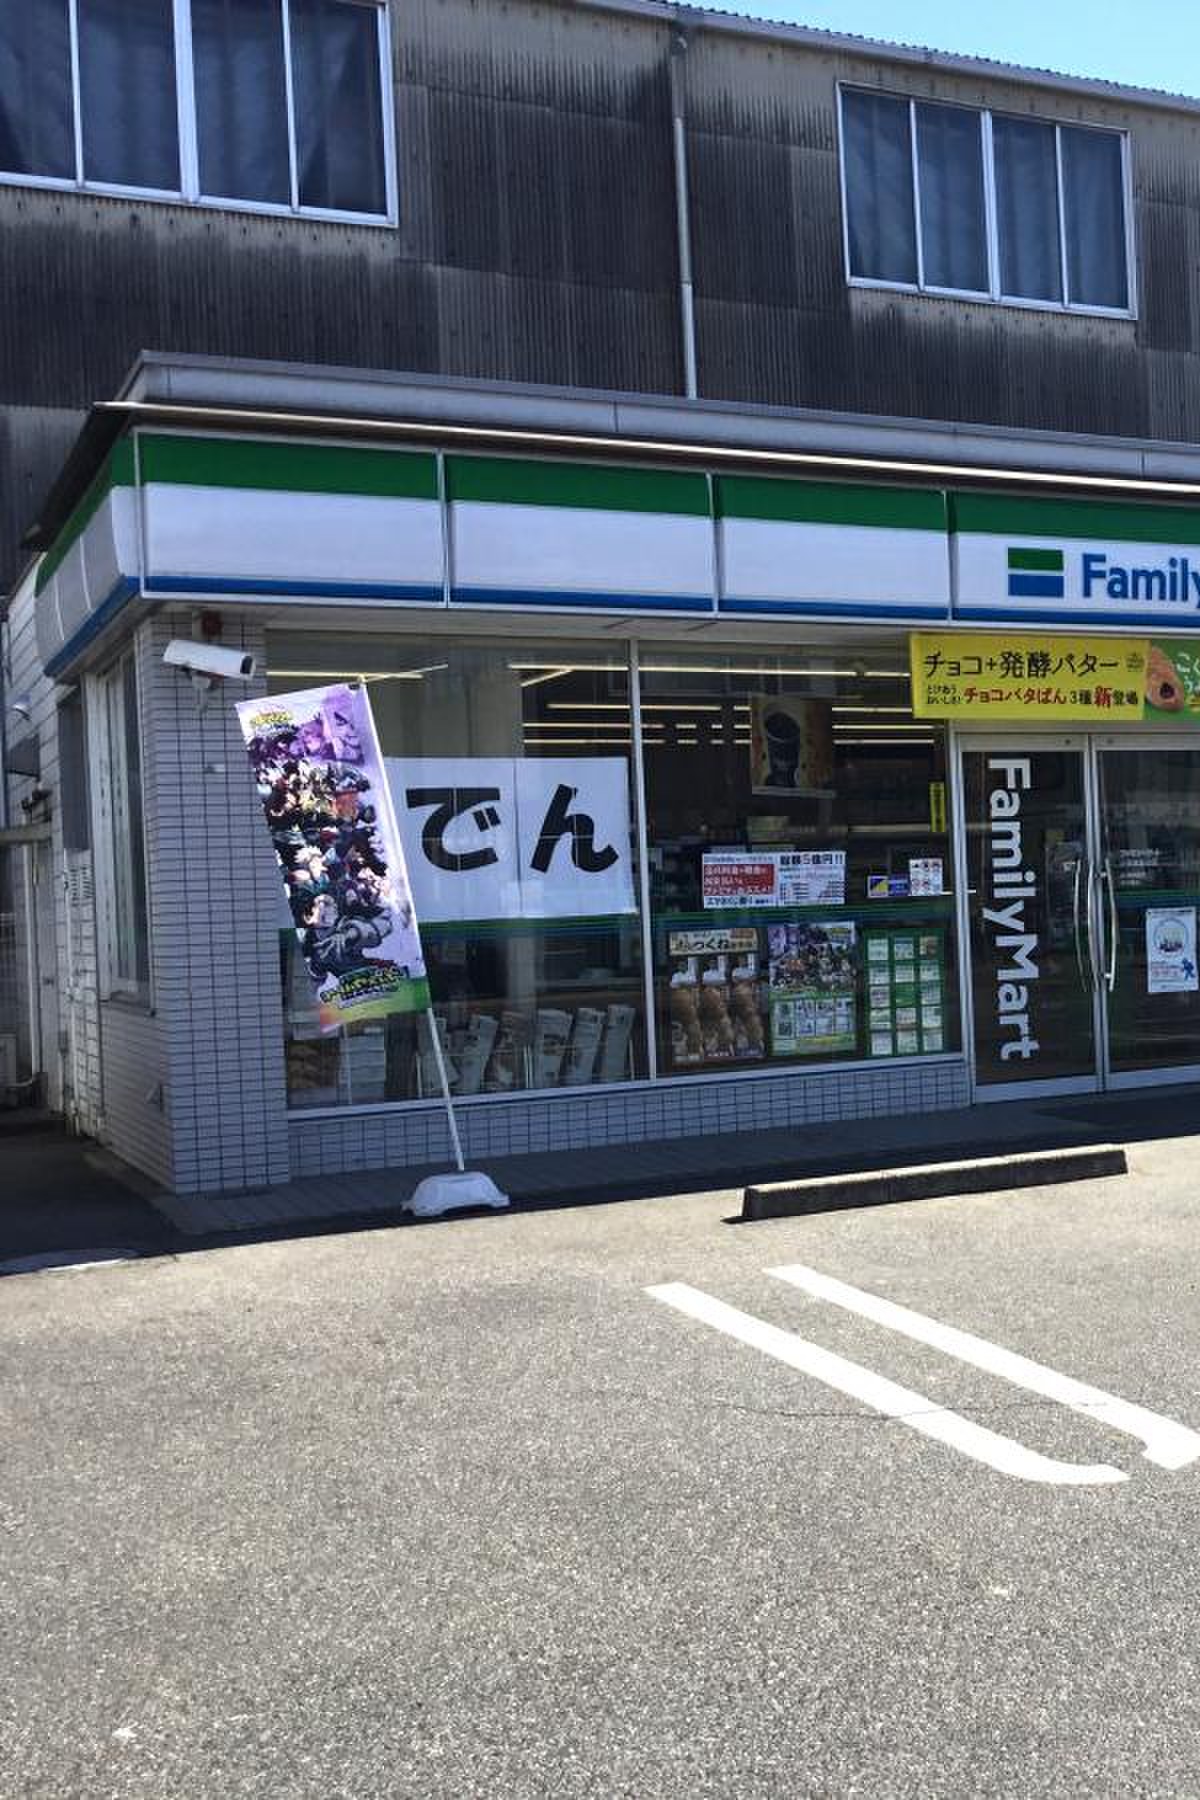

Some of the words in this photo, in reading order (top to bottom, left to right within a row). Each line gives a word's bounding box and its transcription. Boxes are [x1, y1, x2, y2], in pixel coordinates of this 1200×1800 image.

[923, 650, 1119, 679] チョコ+発酵バター
[405, 783, 620, 874] でん
[982, 757, 1040, 1061] FamilyMart
